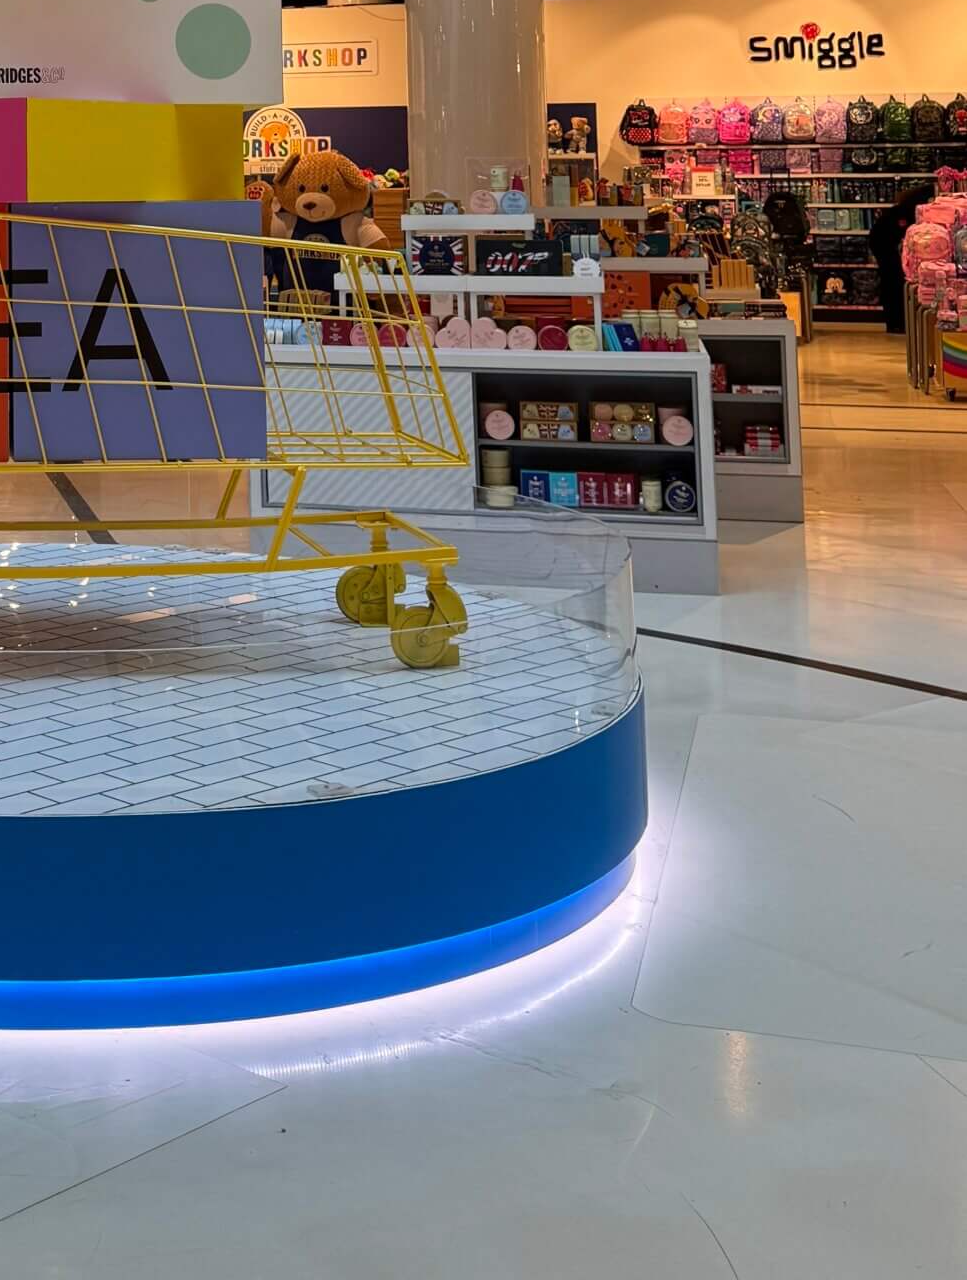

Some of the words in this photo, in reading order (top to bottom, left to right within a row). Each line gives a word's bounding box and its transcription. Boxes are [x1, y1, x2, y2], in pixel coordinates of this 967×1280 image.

[749, 23, 885, 70] smiggle
[284, 47, 368, 68] RKSHOP
[243, 138, 329, 158] ORKSHOP
